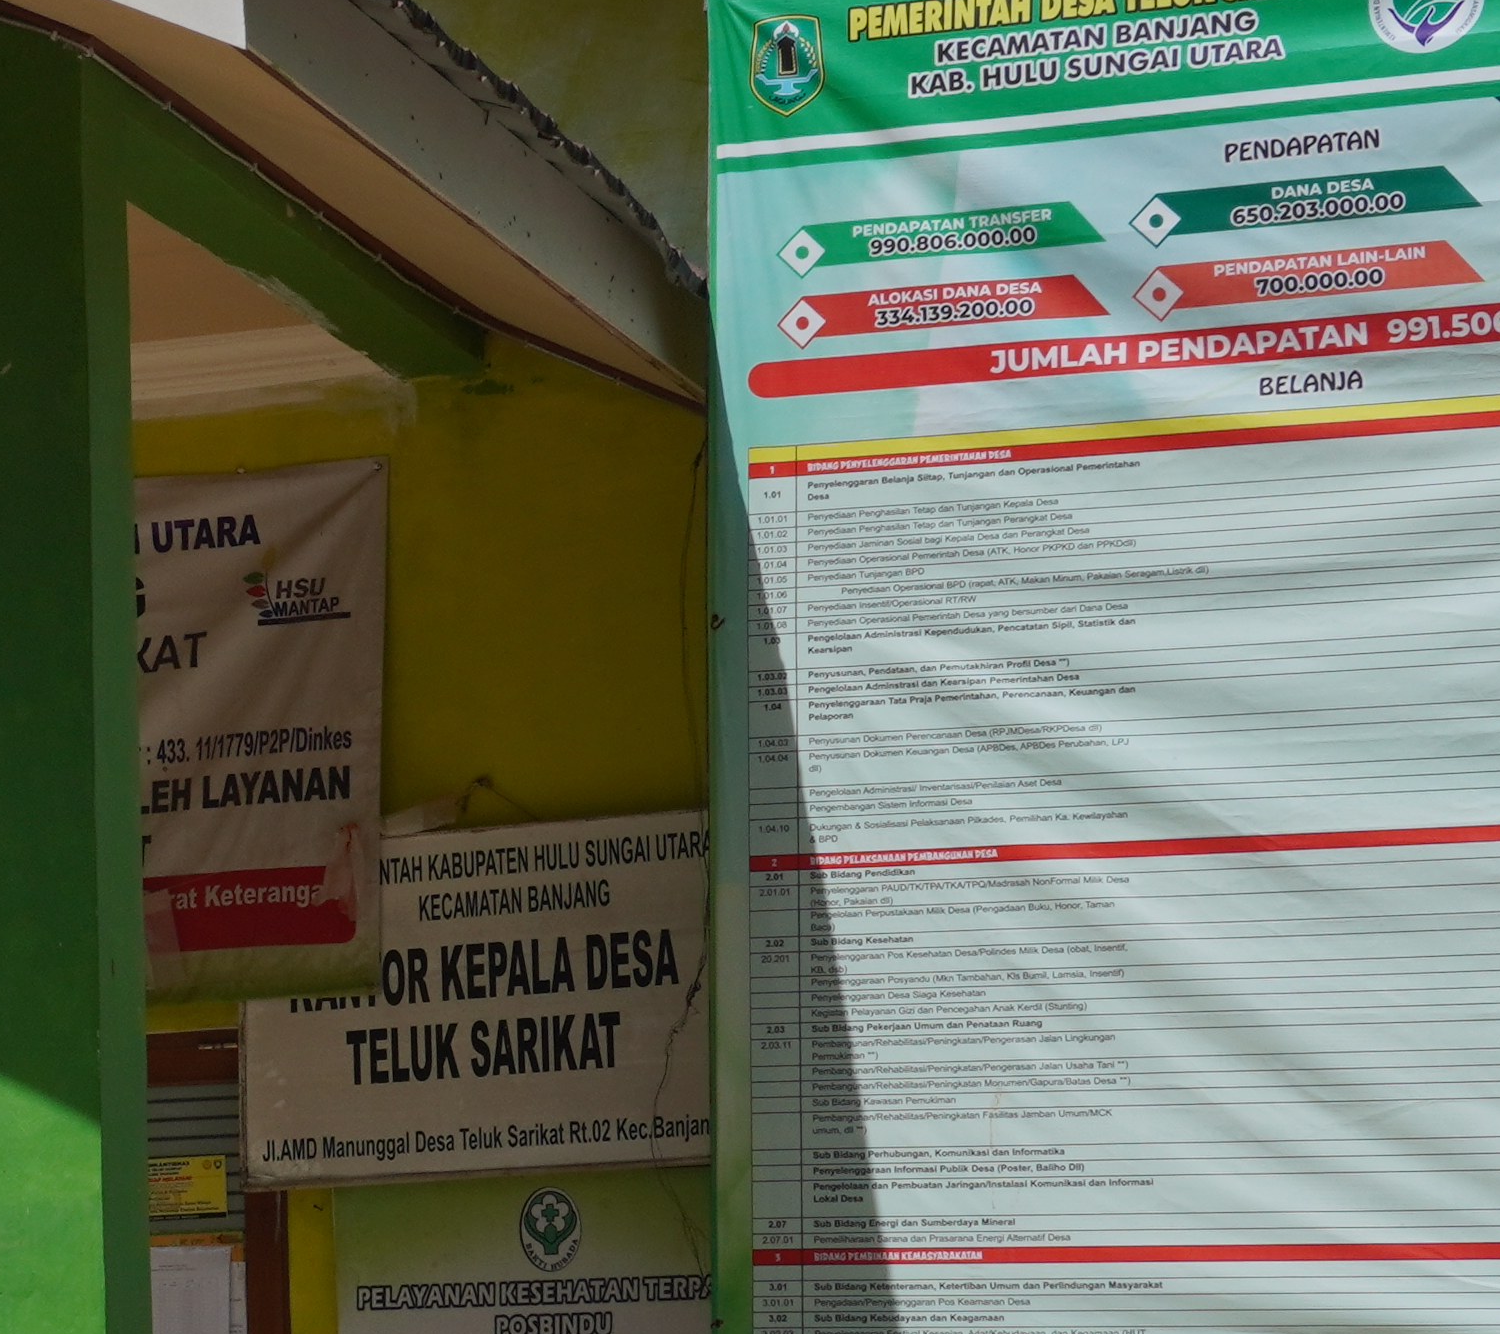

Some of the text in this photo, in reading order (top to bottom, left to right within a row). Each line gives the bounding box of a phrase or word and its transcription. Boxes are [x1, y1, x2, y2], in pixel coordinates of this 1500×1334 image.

[937, 10, 1257, 64] KECAMATAN BANJANG
[909, 68, 975, 97] KAB.
[983, 60, 1057, 91] HULU
[1064, 48, 1179, 81] SUNGAI
[1225, 129, 1379, 163] PENDAPATAN
[1270, 177, 1375, 200] DANA DESA
[852, 208, 1052, 239] PENDAPATAN TRANSFER
[1231, 192, 1404, 225] 650.203.000.00
[868, 226, 1038, 257] 990.806.000.00
[1213, 245, 1426, 278] PENDAPATAN LAIN-LAIN
[868, 281, 1042, 307] ALOKASI DANA DESA
[1255, 266, 1385, 298] 700.000.00
[874, 297, 1036, 329] 334.139.200.00
[989, 340, 1128, 375] JUMLAH
[1137, 321, 1368, 364] PENDAPATAN
[1258, 369, 1365, 397] BELANJA
[152, 514, 261, 554] UTARA
[275, 577, 326, 599] HSU
[274, 596, 340, 617] MANTAP
[202, 765, 350, 809] LAYANAN
[427, 847, 530, 882] KABUPATEN
[534, 843, 580, 869] HULU
[586, 837, 651, 867] SUNGAI
[418, 879, 611, 922] KECAMATAN BANJANG
[441, 937, 582, 1001] KEPALA
[586, 929, 680, 991] DESA
[346, 1012, 621, 1086] TELUK SARIKAT
[322, 1133, 410, 1161] Manunggal
[415, 1130, 454, 1152] Desa
[461, 1127, 502, 1150] Teluk
[507, 1124, 565, 1149] Sarikat
[570, 1120, 610, 1144] Rt.02
[616, 1116, 710, 1142] Kec.Banjan
